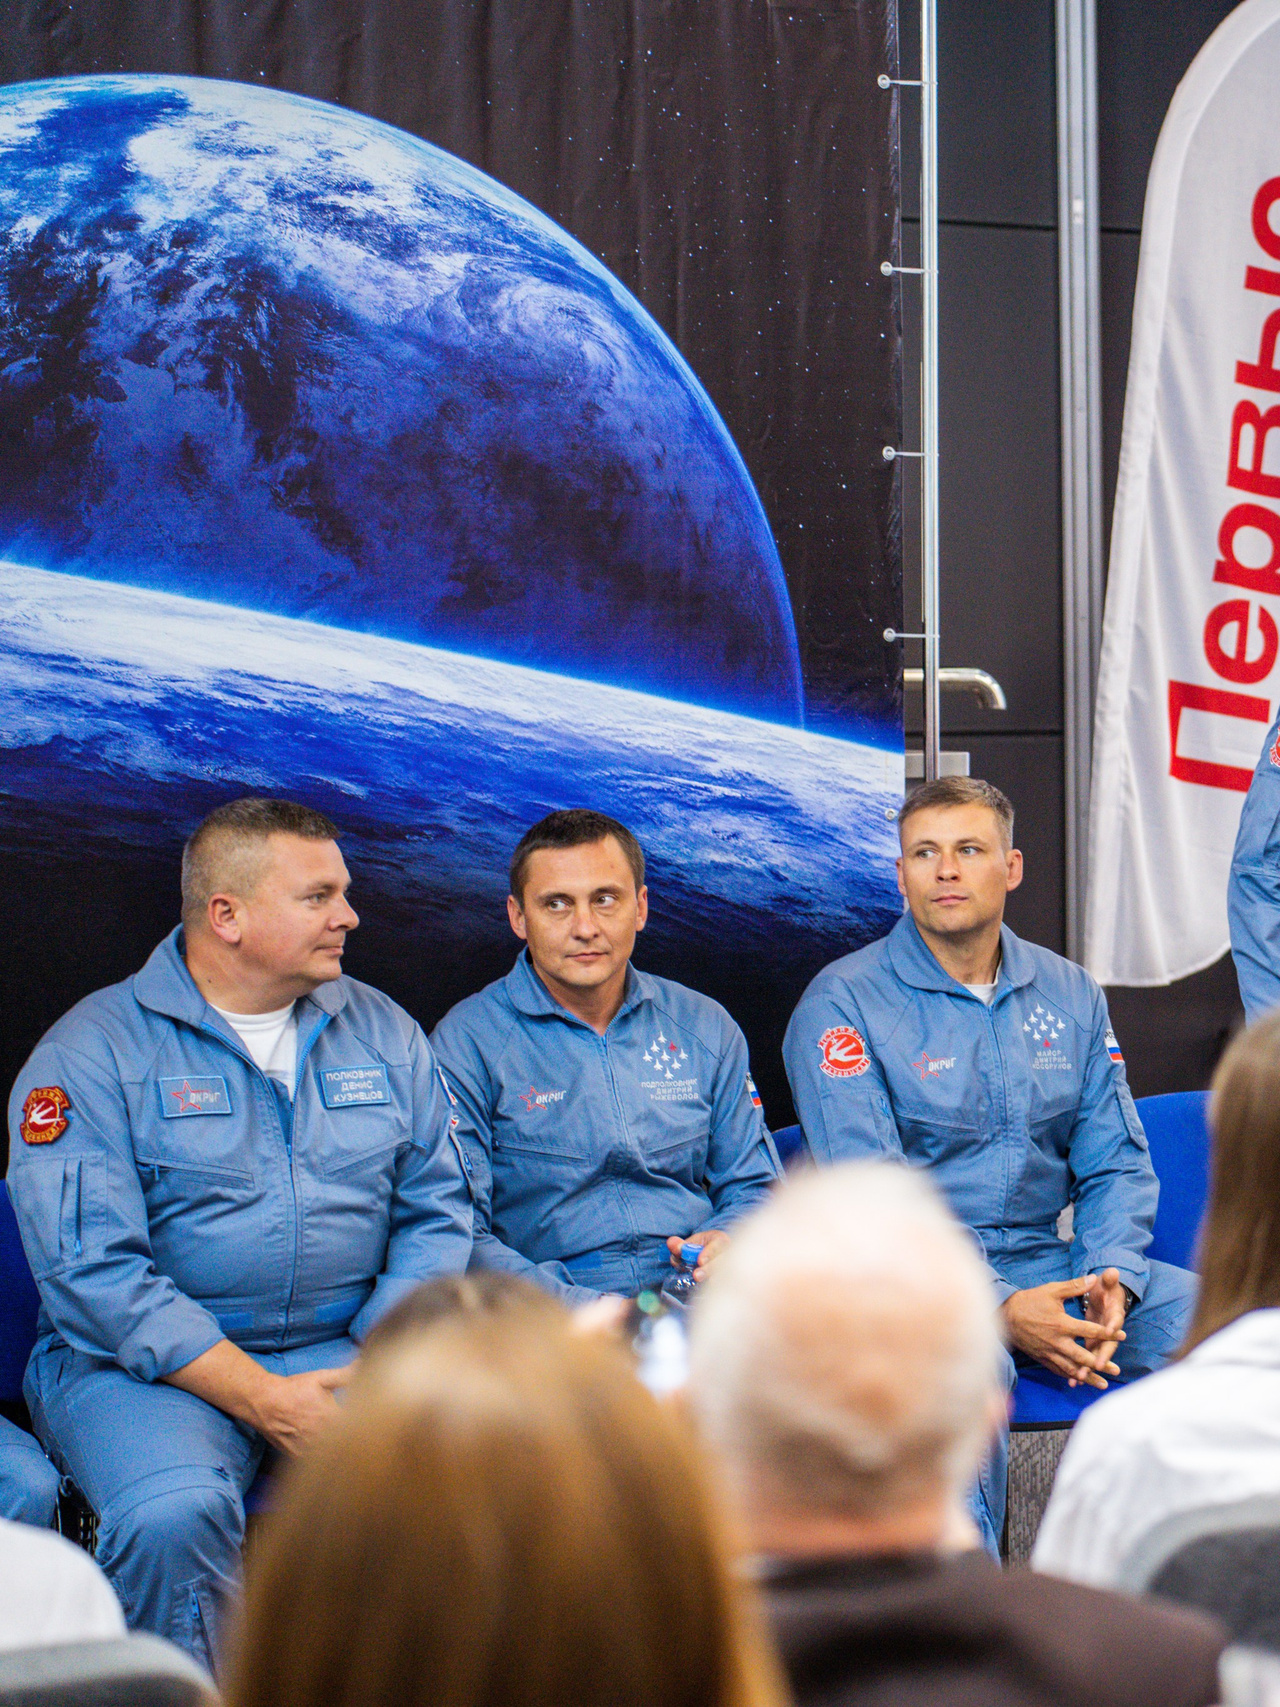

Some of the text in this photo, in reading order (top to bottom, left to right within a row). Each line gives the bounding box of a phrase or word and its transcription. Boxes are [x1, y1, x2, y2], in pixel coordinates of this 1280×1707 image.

[325, 1069, 383, 1082] ПОЛКОВНИК
[340, 1080, 374, 1093] ДЕНИС
[641, 1078, 698, 1089] ПОДПОЛКОВНИК
[333, 1090, 384, 1103] КУЗНЕЦОВ
